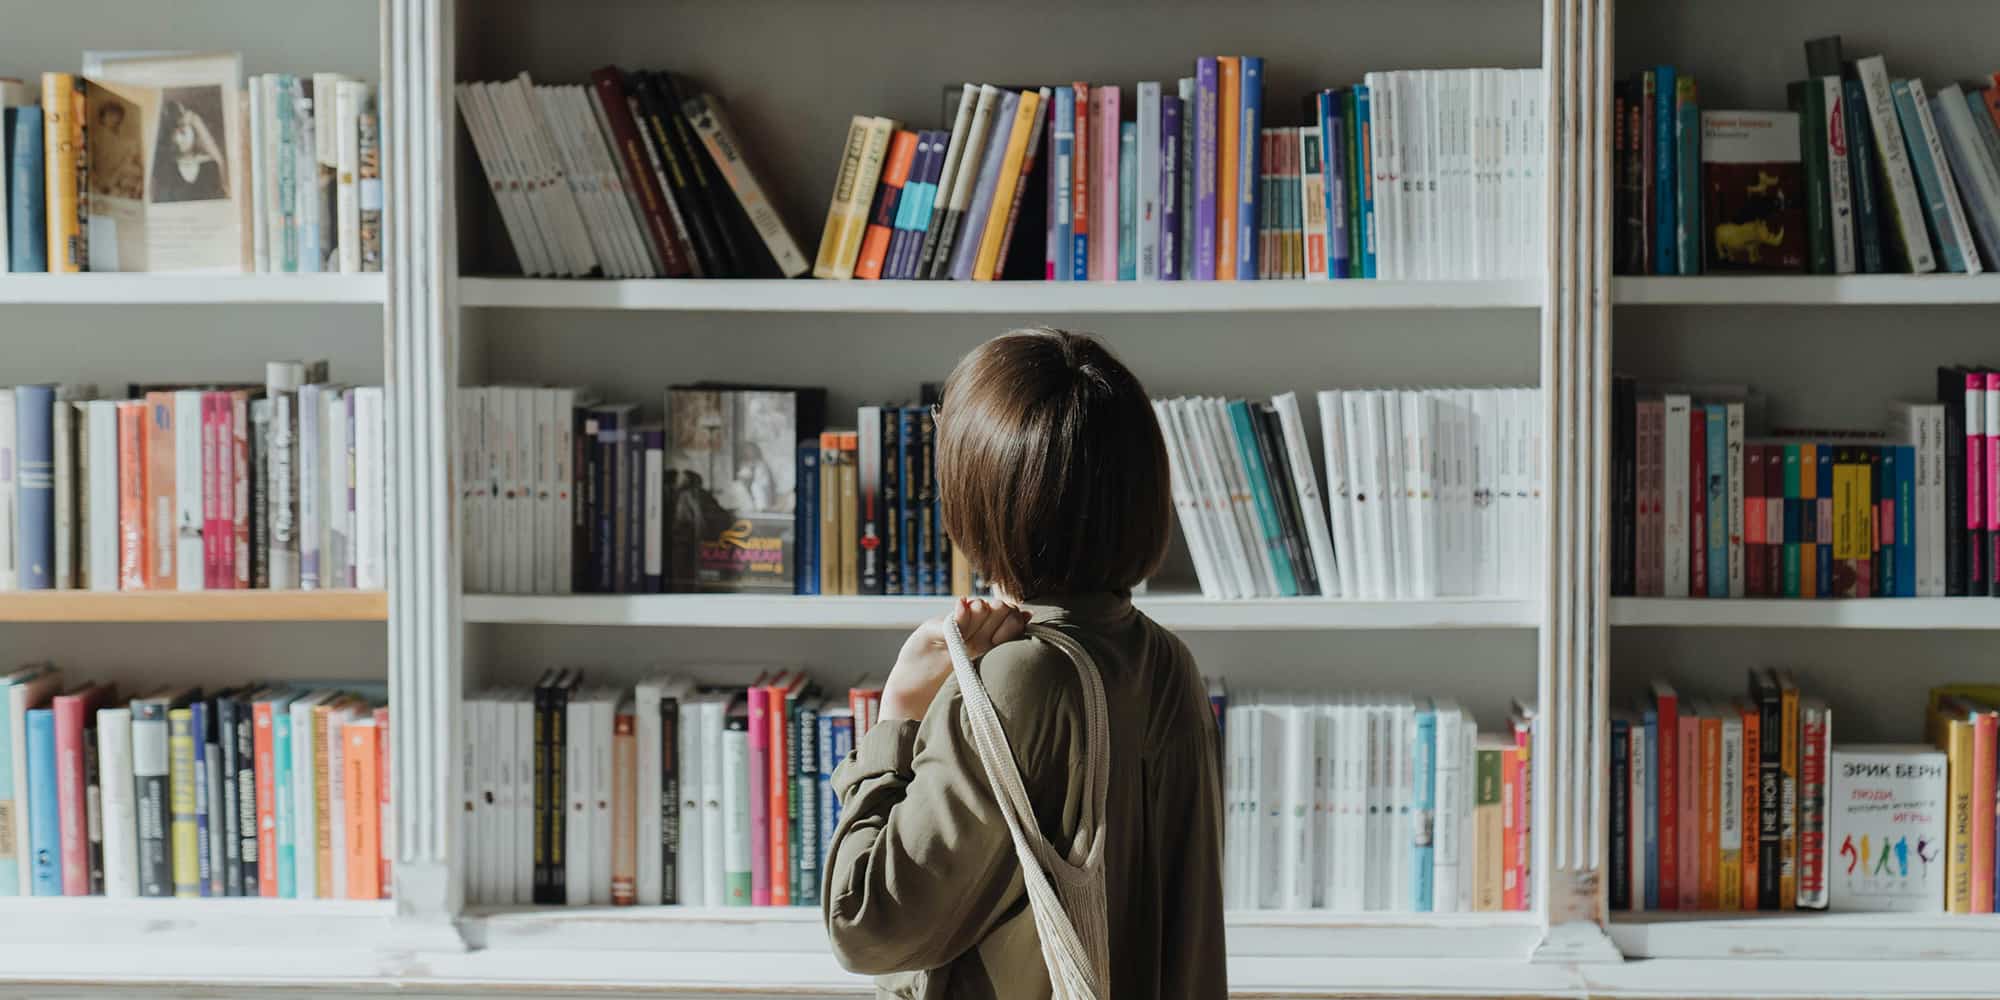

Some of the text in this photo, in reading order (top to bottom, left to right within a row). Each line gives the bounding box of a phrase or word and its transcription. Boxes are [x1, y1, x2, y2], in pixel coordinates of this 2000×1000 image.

[1843, 763, 1942, 778] ЭРИК БЕРН
[1956, 793, 1968, 902] TELL ME MORE
